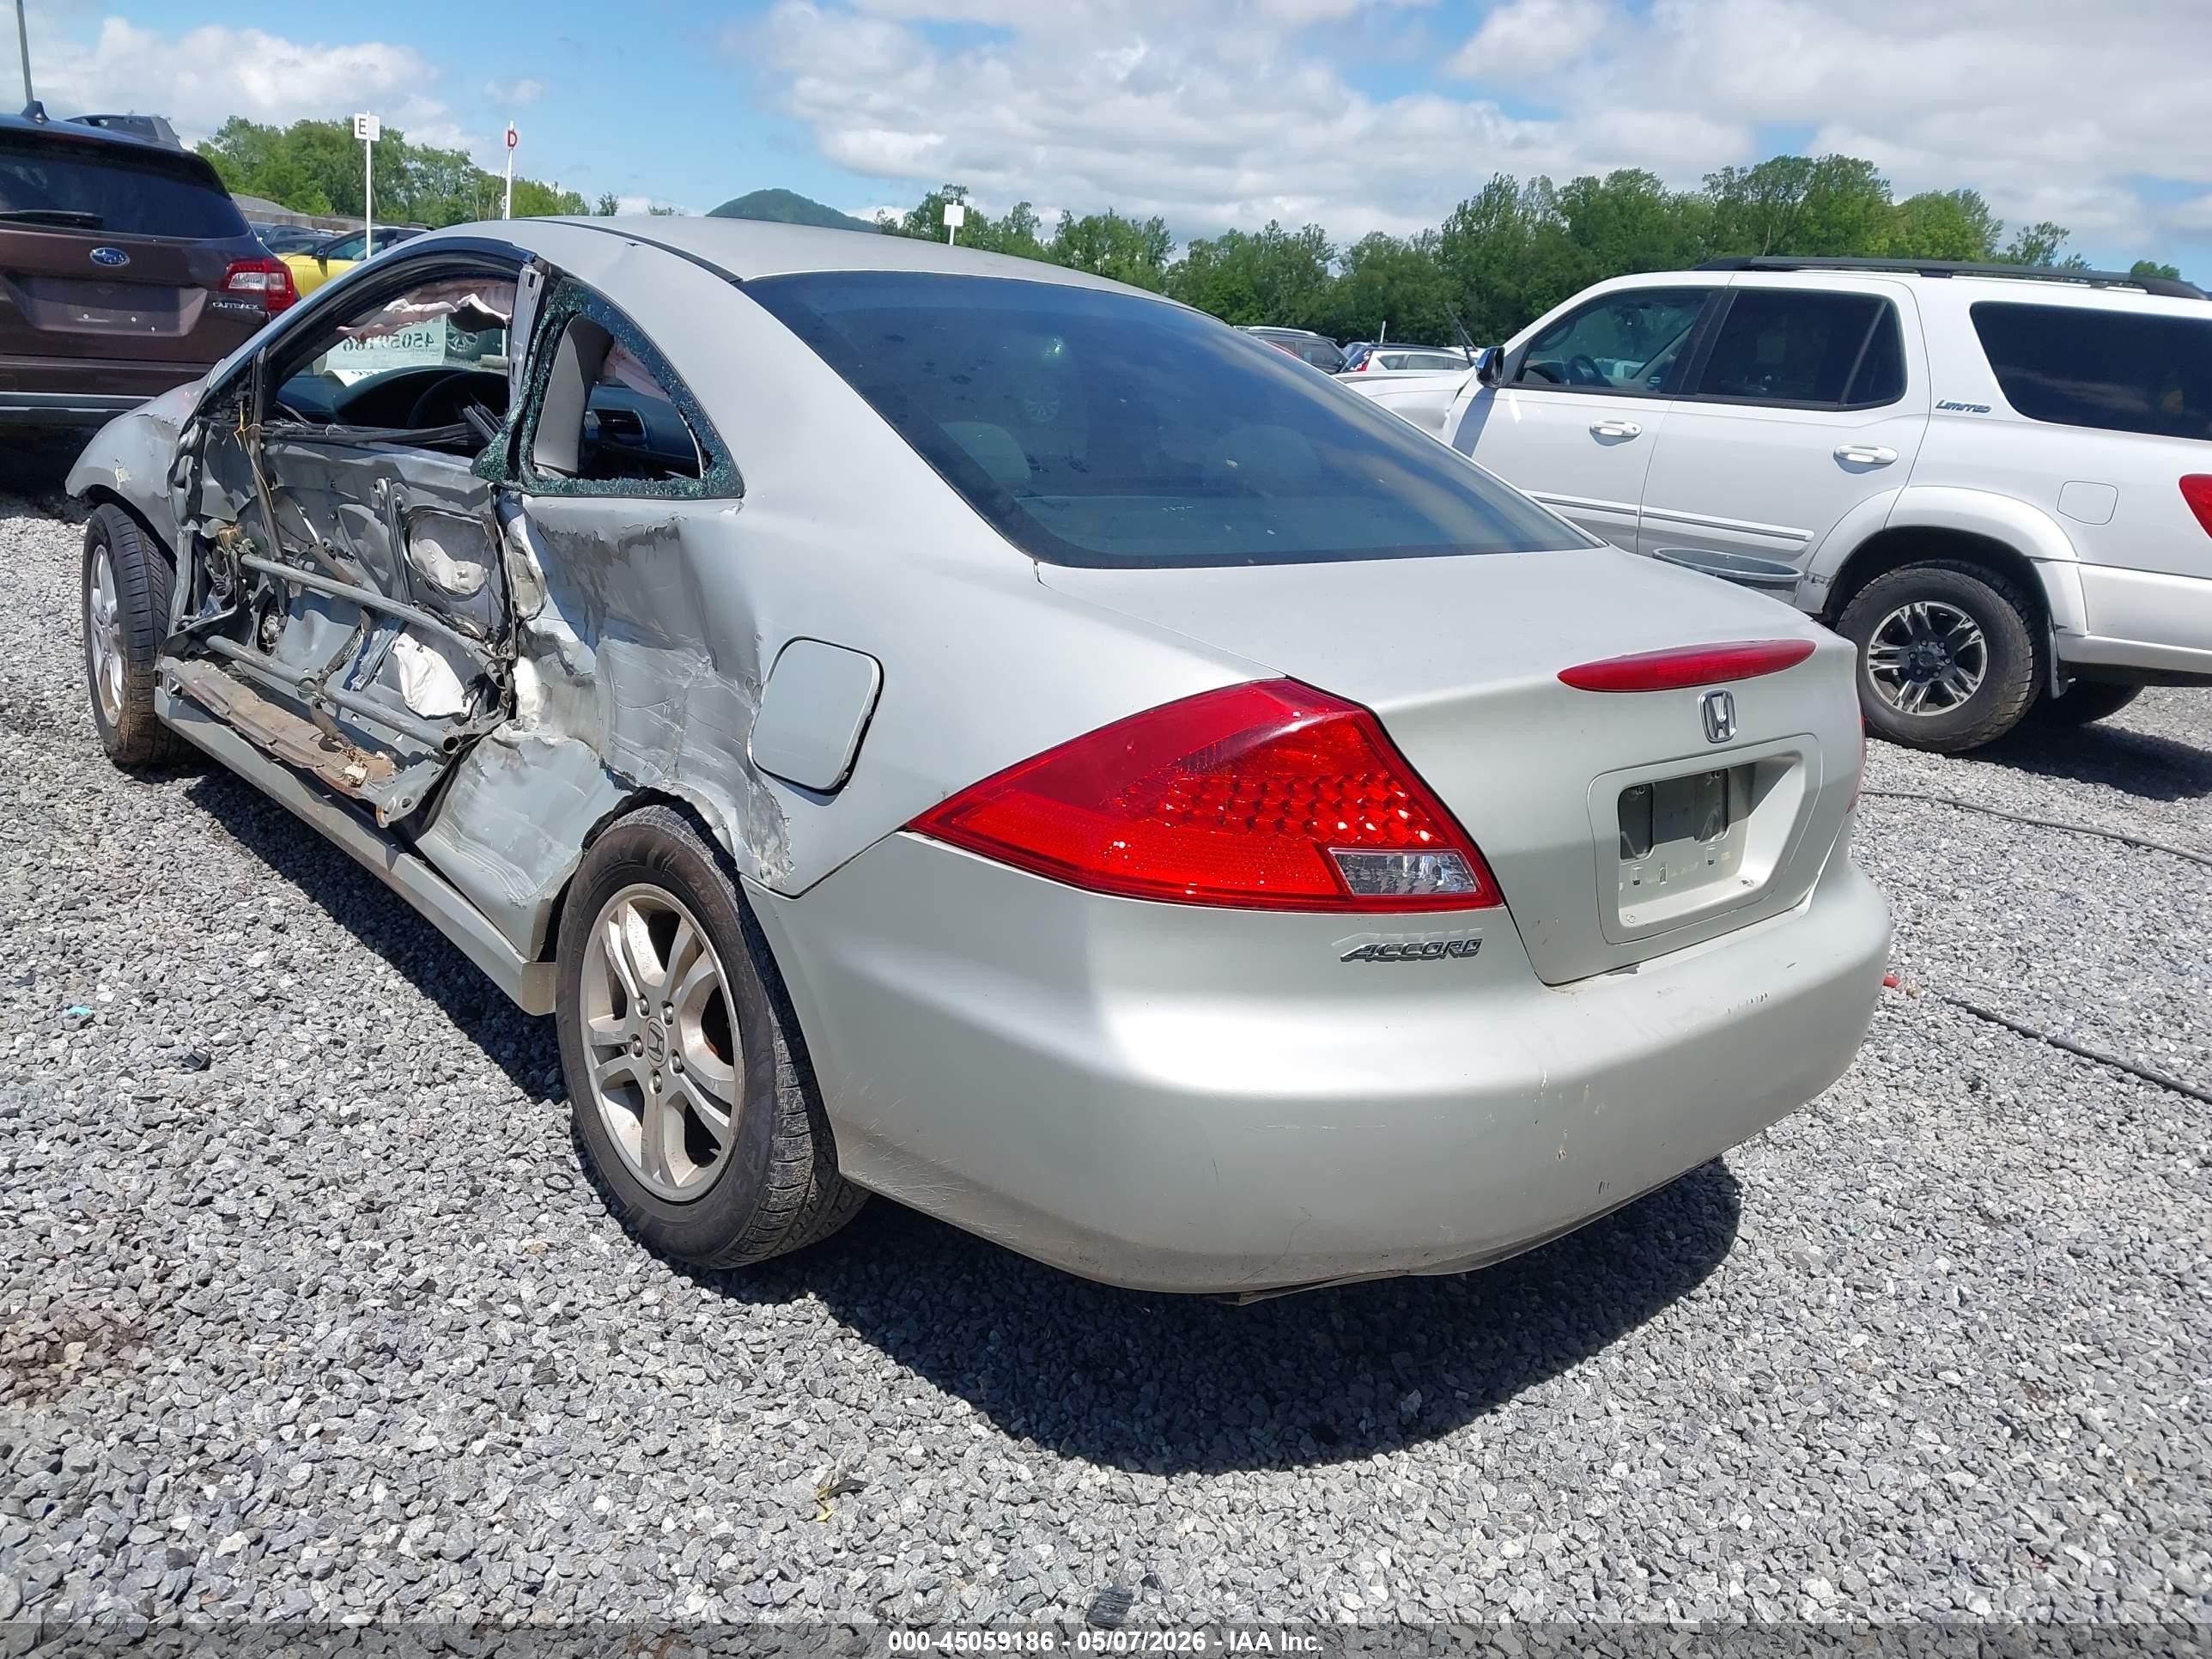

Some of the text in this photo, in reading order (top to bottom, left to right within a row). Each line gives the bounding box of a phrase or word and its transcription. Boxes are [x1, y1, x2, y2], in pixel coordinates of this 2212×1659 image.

[358, 118, 368, 135] E
[507, 130, 518, 148] D
[212, 301, 259, 310] OUTBACK
[1340, 938, 1484, 963] ACCORD
